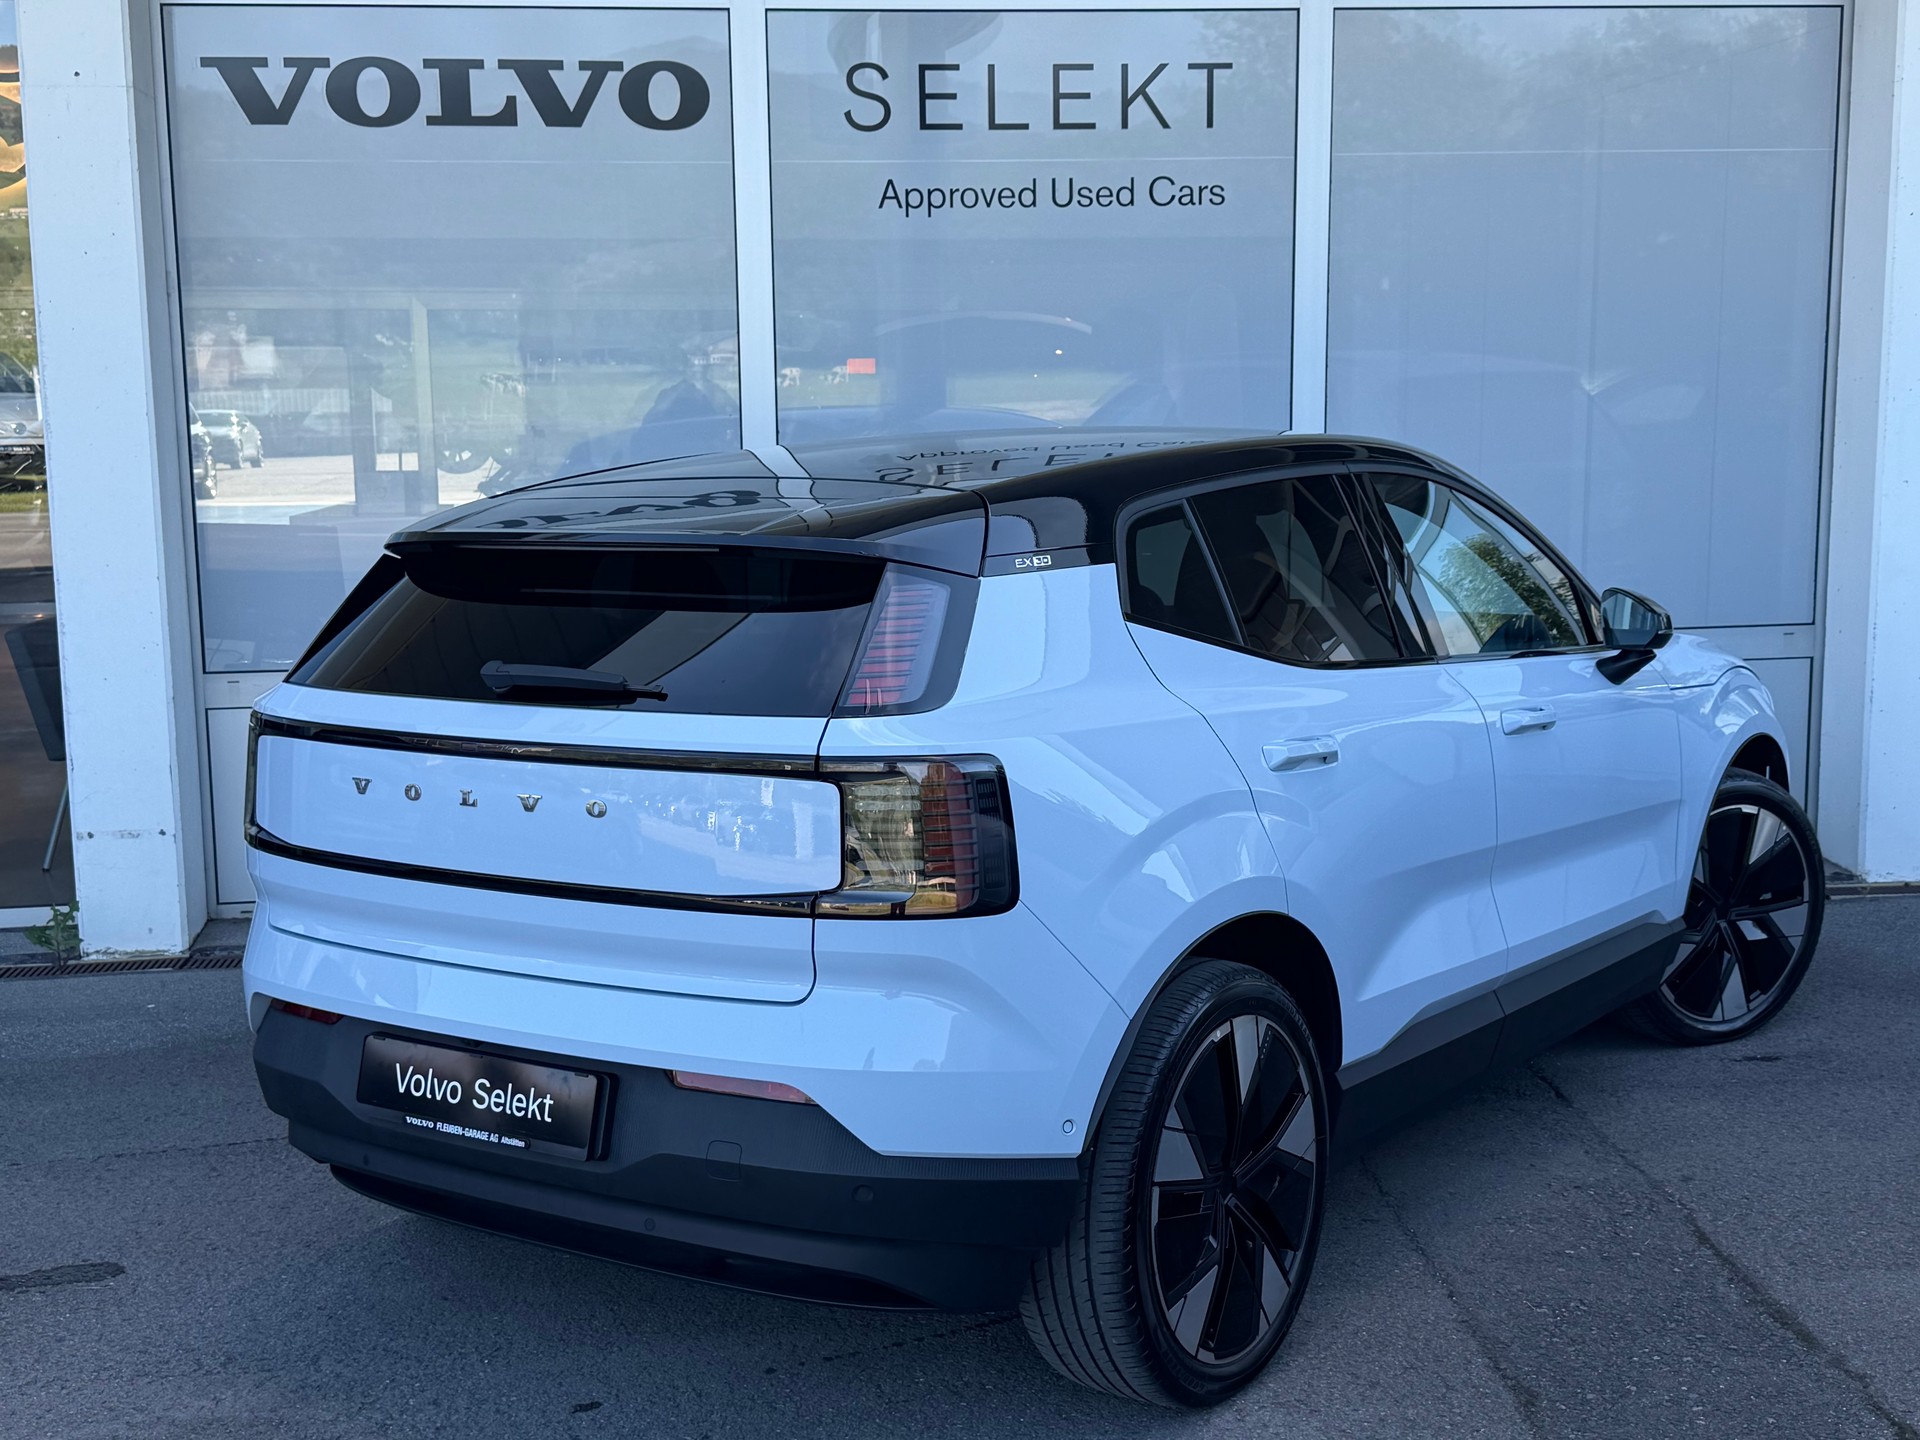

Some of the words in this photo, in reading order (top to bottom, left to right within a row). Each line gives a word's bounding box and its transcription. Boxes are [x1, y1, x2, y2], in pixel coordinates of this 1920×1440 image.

[200, 56, 711, 131] VOLVO
[843, 62, 1233, 132] SELEKT
[878, 178, 1037, 218] Approved
[1051, 176, 1135, 209] Used
[1148, 175, 1226, 207] Cars
[352, 776, 608, 818] VOLVO
[395, 1062, 462, 1105] Volvo
[472, 1078, 555, 1123] Selekt
[405, 1116, 434, 1129] VOLVO
[436, 1121, 489, 1141] FLEUBEN-GARAGE
[489, 1132, 499, 1143] AG
